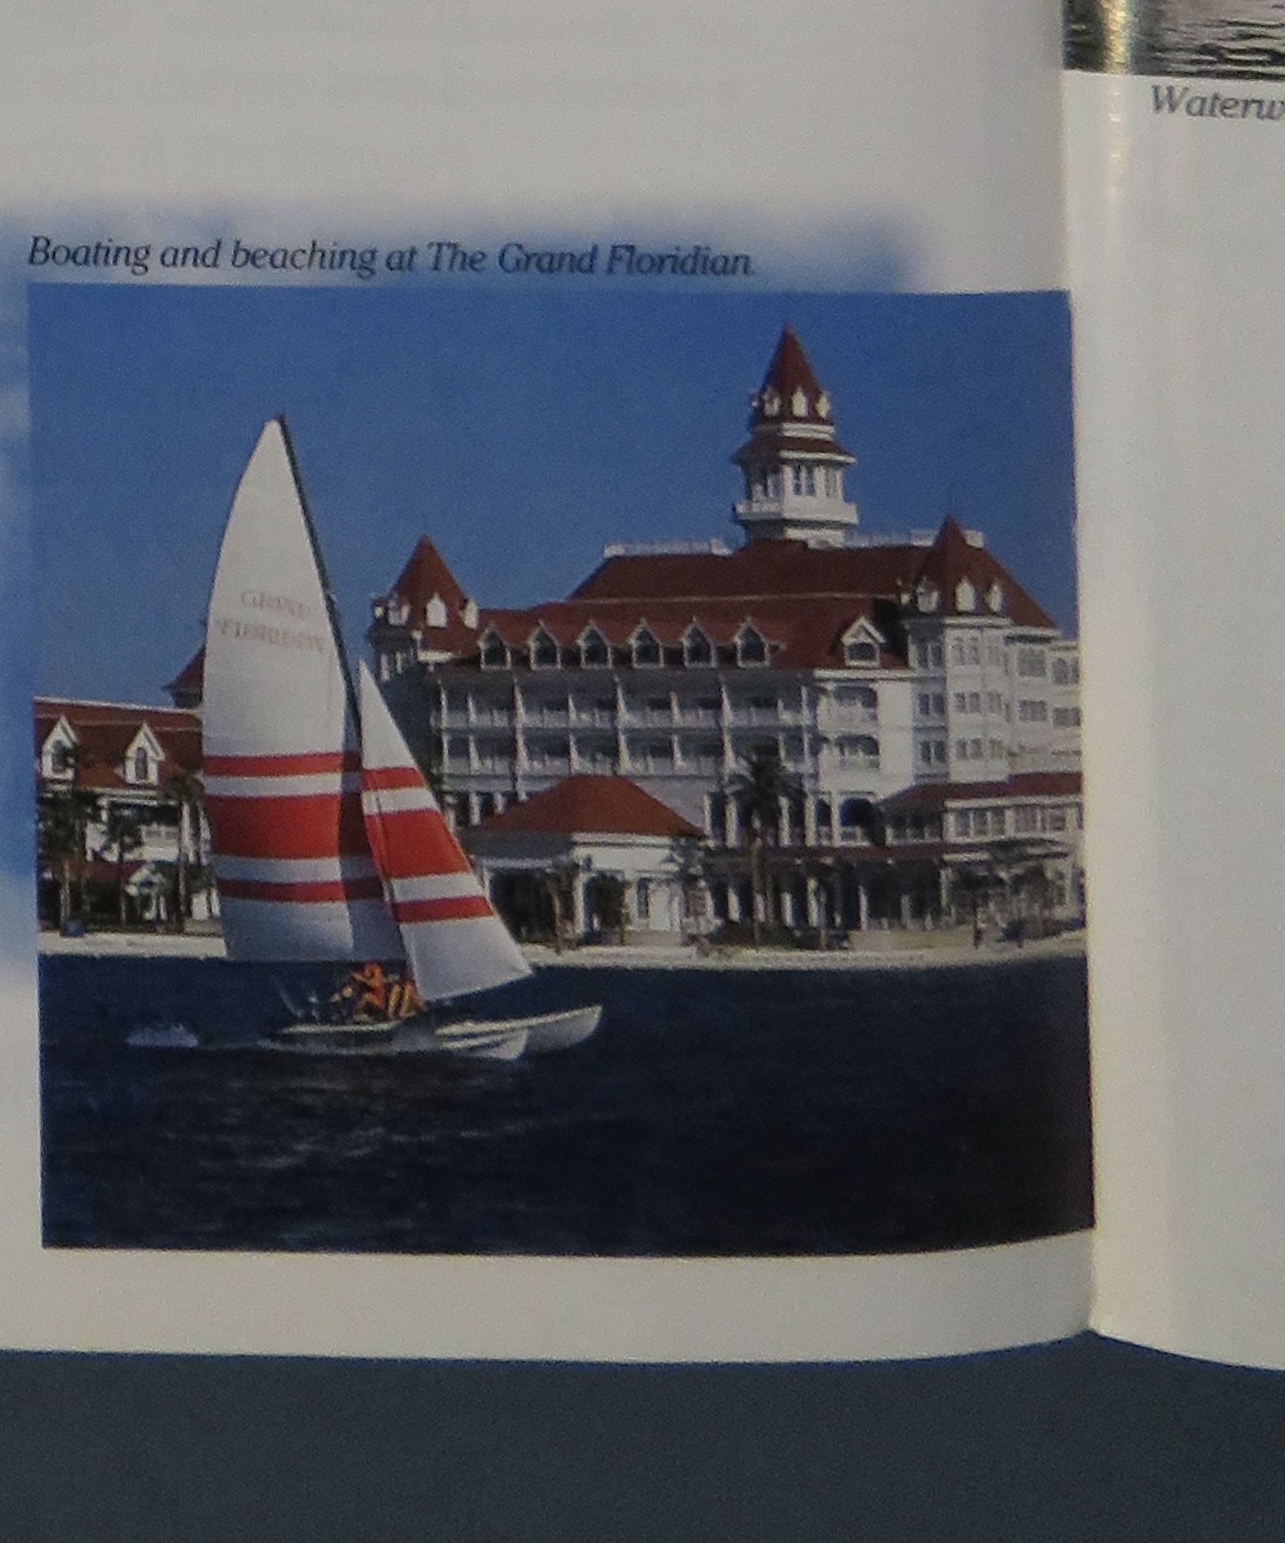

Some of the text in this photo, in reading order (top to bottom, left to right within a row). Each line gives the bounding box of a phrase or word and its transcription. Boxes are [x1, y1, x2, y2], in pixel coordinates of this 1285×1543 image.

[28, 236, 151, 272] Boating
[160, 238, 222, 268] and
[231, 239, 377, 275] beaching
[386, 246, 417, 271] at
[428, 242, 486, 271] The
[499, 243, 598, 273] Grand
